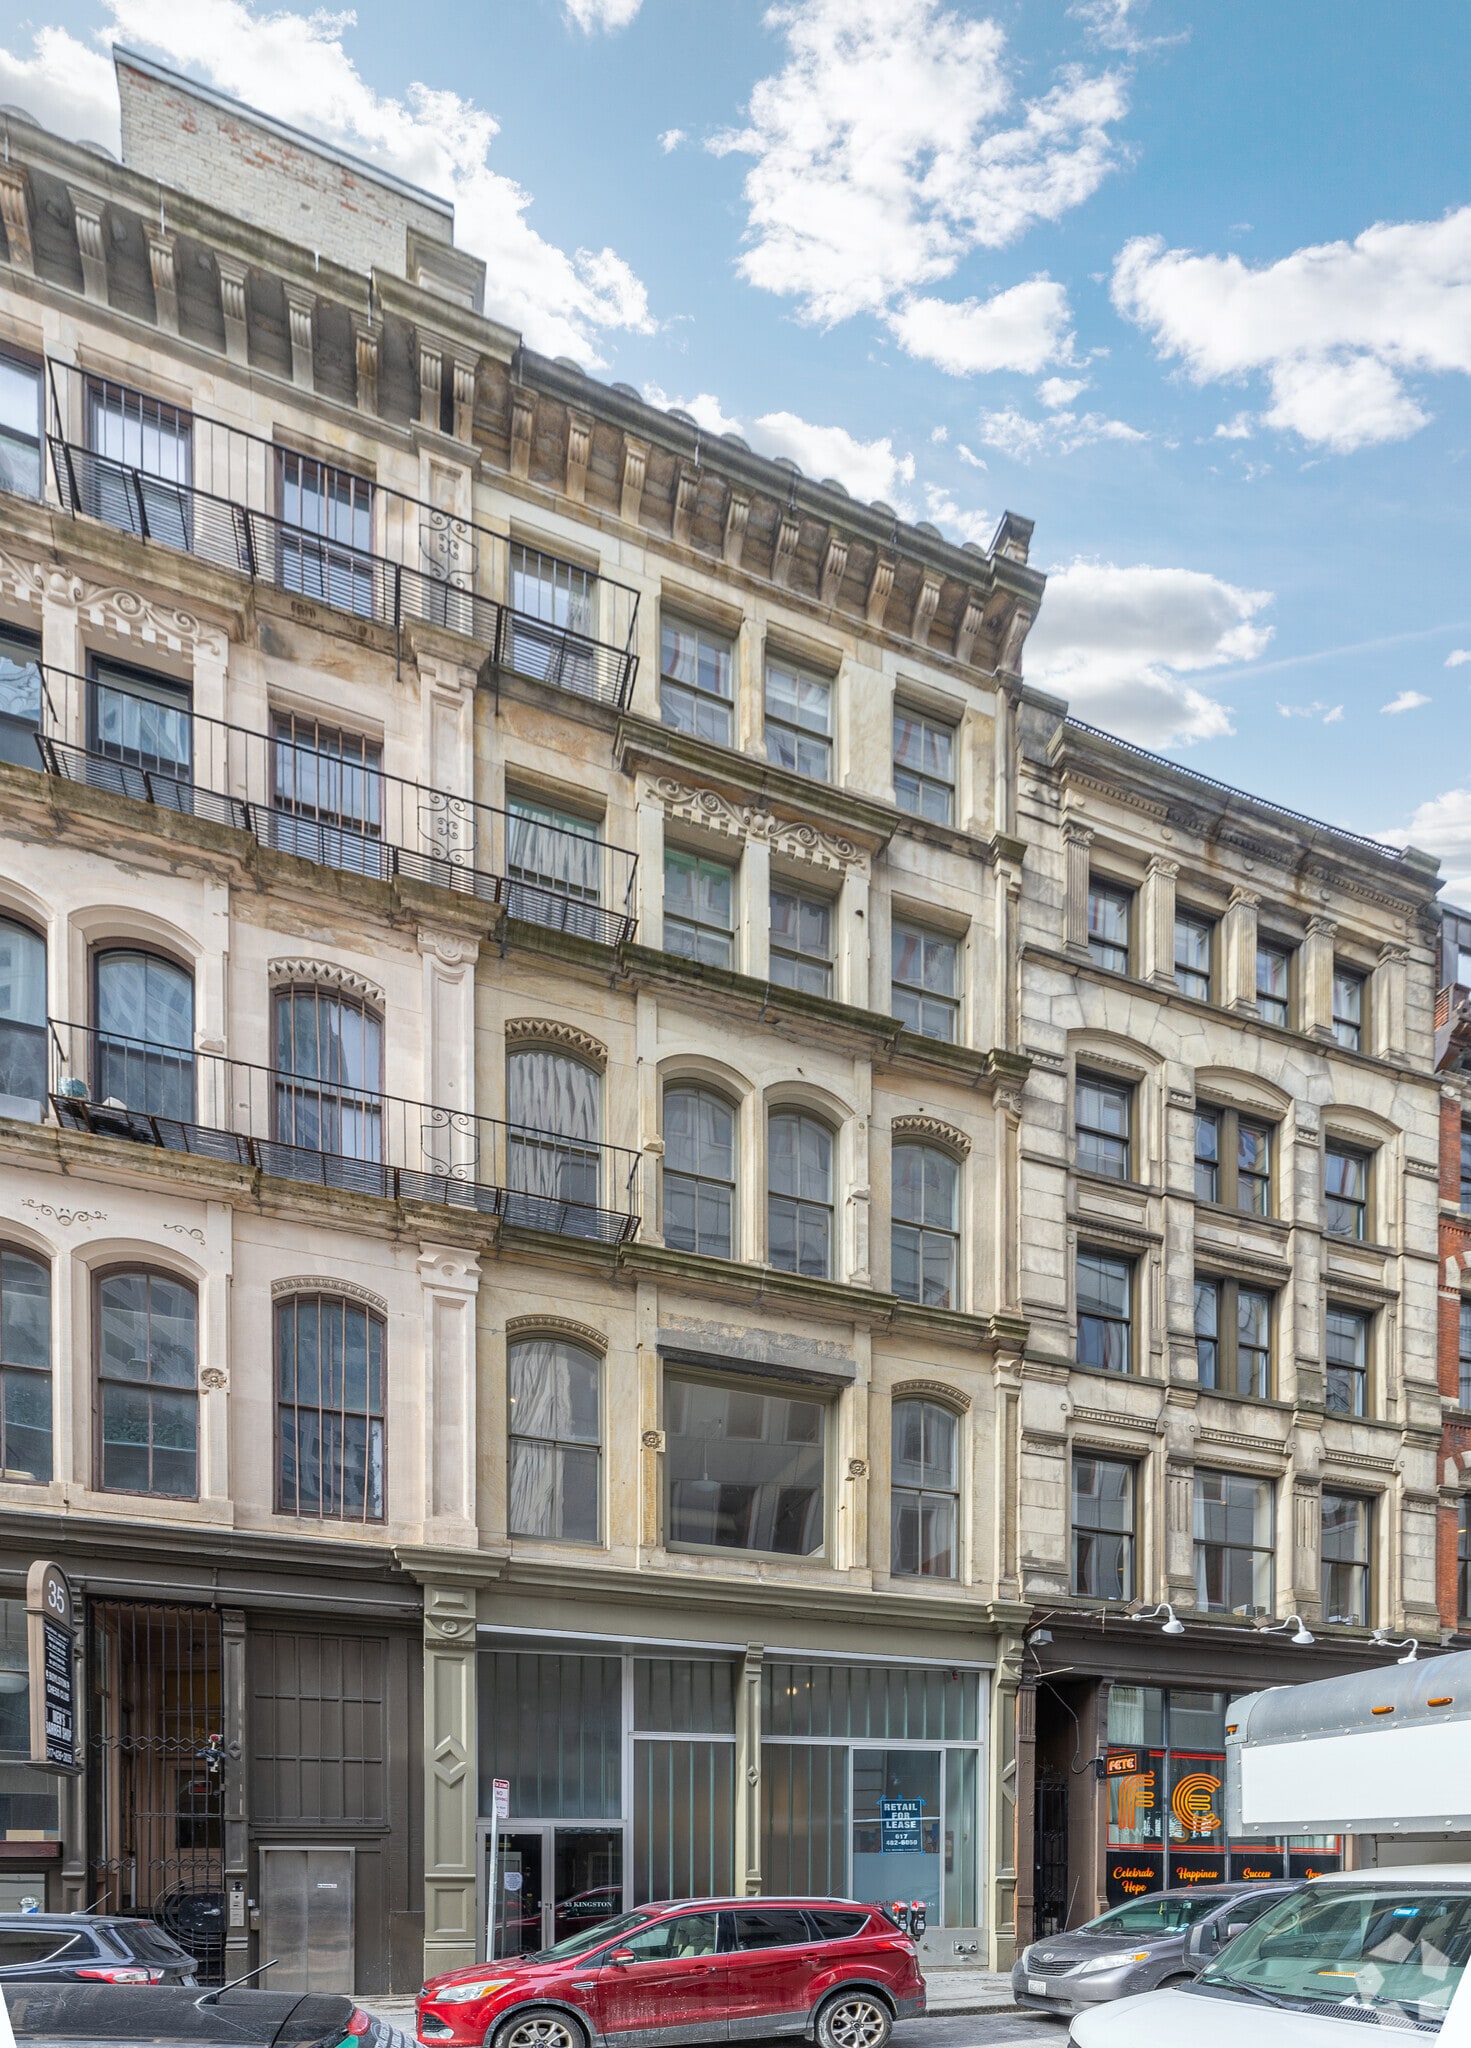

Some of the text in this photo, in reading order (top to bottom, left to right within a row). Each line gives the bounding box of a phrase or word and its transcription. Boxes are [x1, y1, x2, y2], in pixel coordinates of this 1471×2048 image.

[48, 1580, 65, 1614] 35
[1109, 1758, 1135, 1771] FETE
[883, 1803, 918, 1811] RETAIL
[891, 1812, 910, 1820] FOR
[886, 1820, 917, 1829] LEASE
[1113, 1866, 1155, 1879] Celebrate
[1176, 1866, 1219, 1882] Happiness
[1242, 1867, 1272, 1880] Success
[1121, 1880, 1147, 1896] Hope
